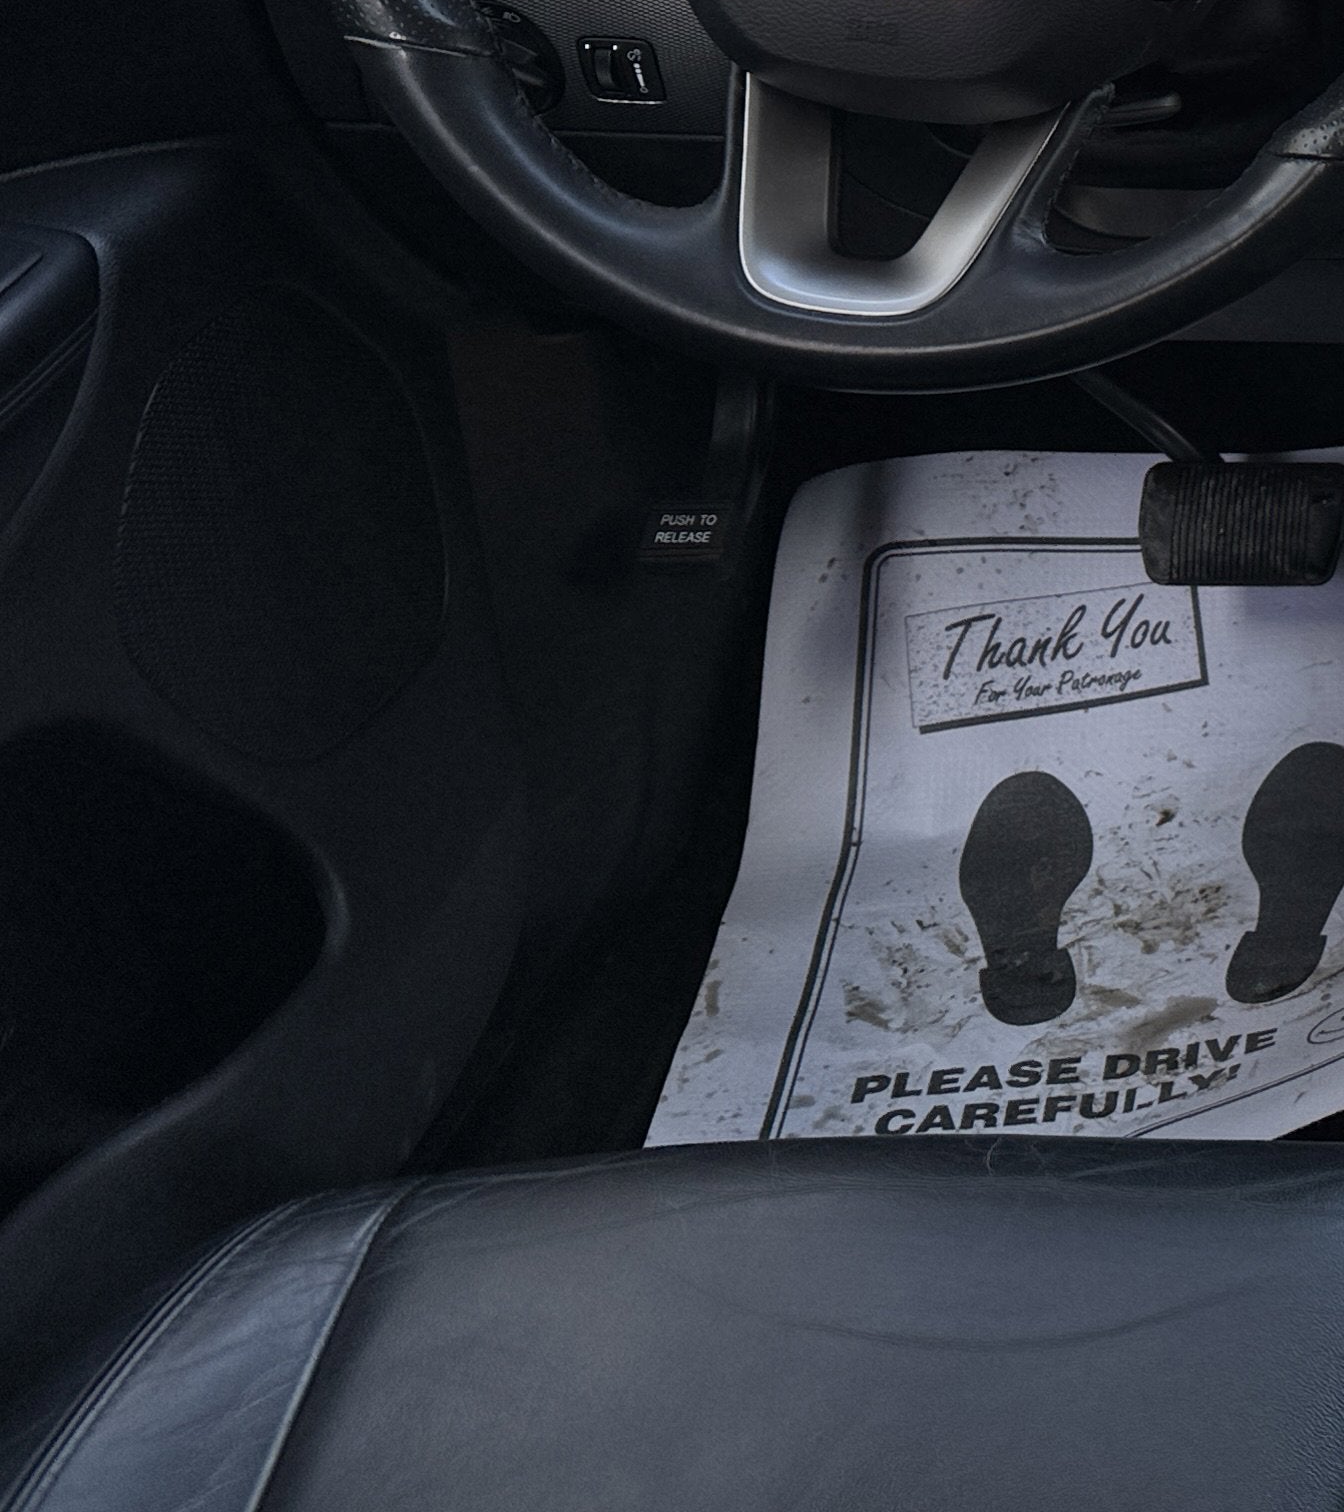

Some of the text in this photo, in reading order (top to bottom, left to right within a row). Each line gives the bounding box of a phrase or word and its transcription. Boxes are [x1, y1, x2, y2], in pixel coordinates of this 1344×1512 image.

[654, 531, 712, 544] RELEASE
[660, 514, 718, 526] PUSH TO
[943, 593, 1173, 681] Thank You
[974, 668, 1142, 705] For Your Patronage
[851, 1028, 1278, 1105] PLEASE DRIVE
